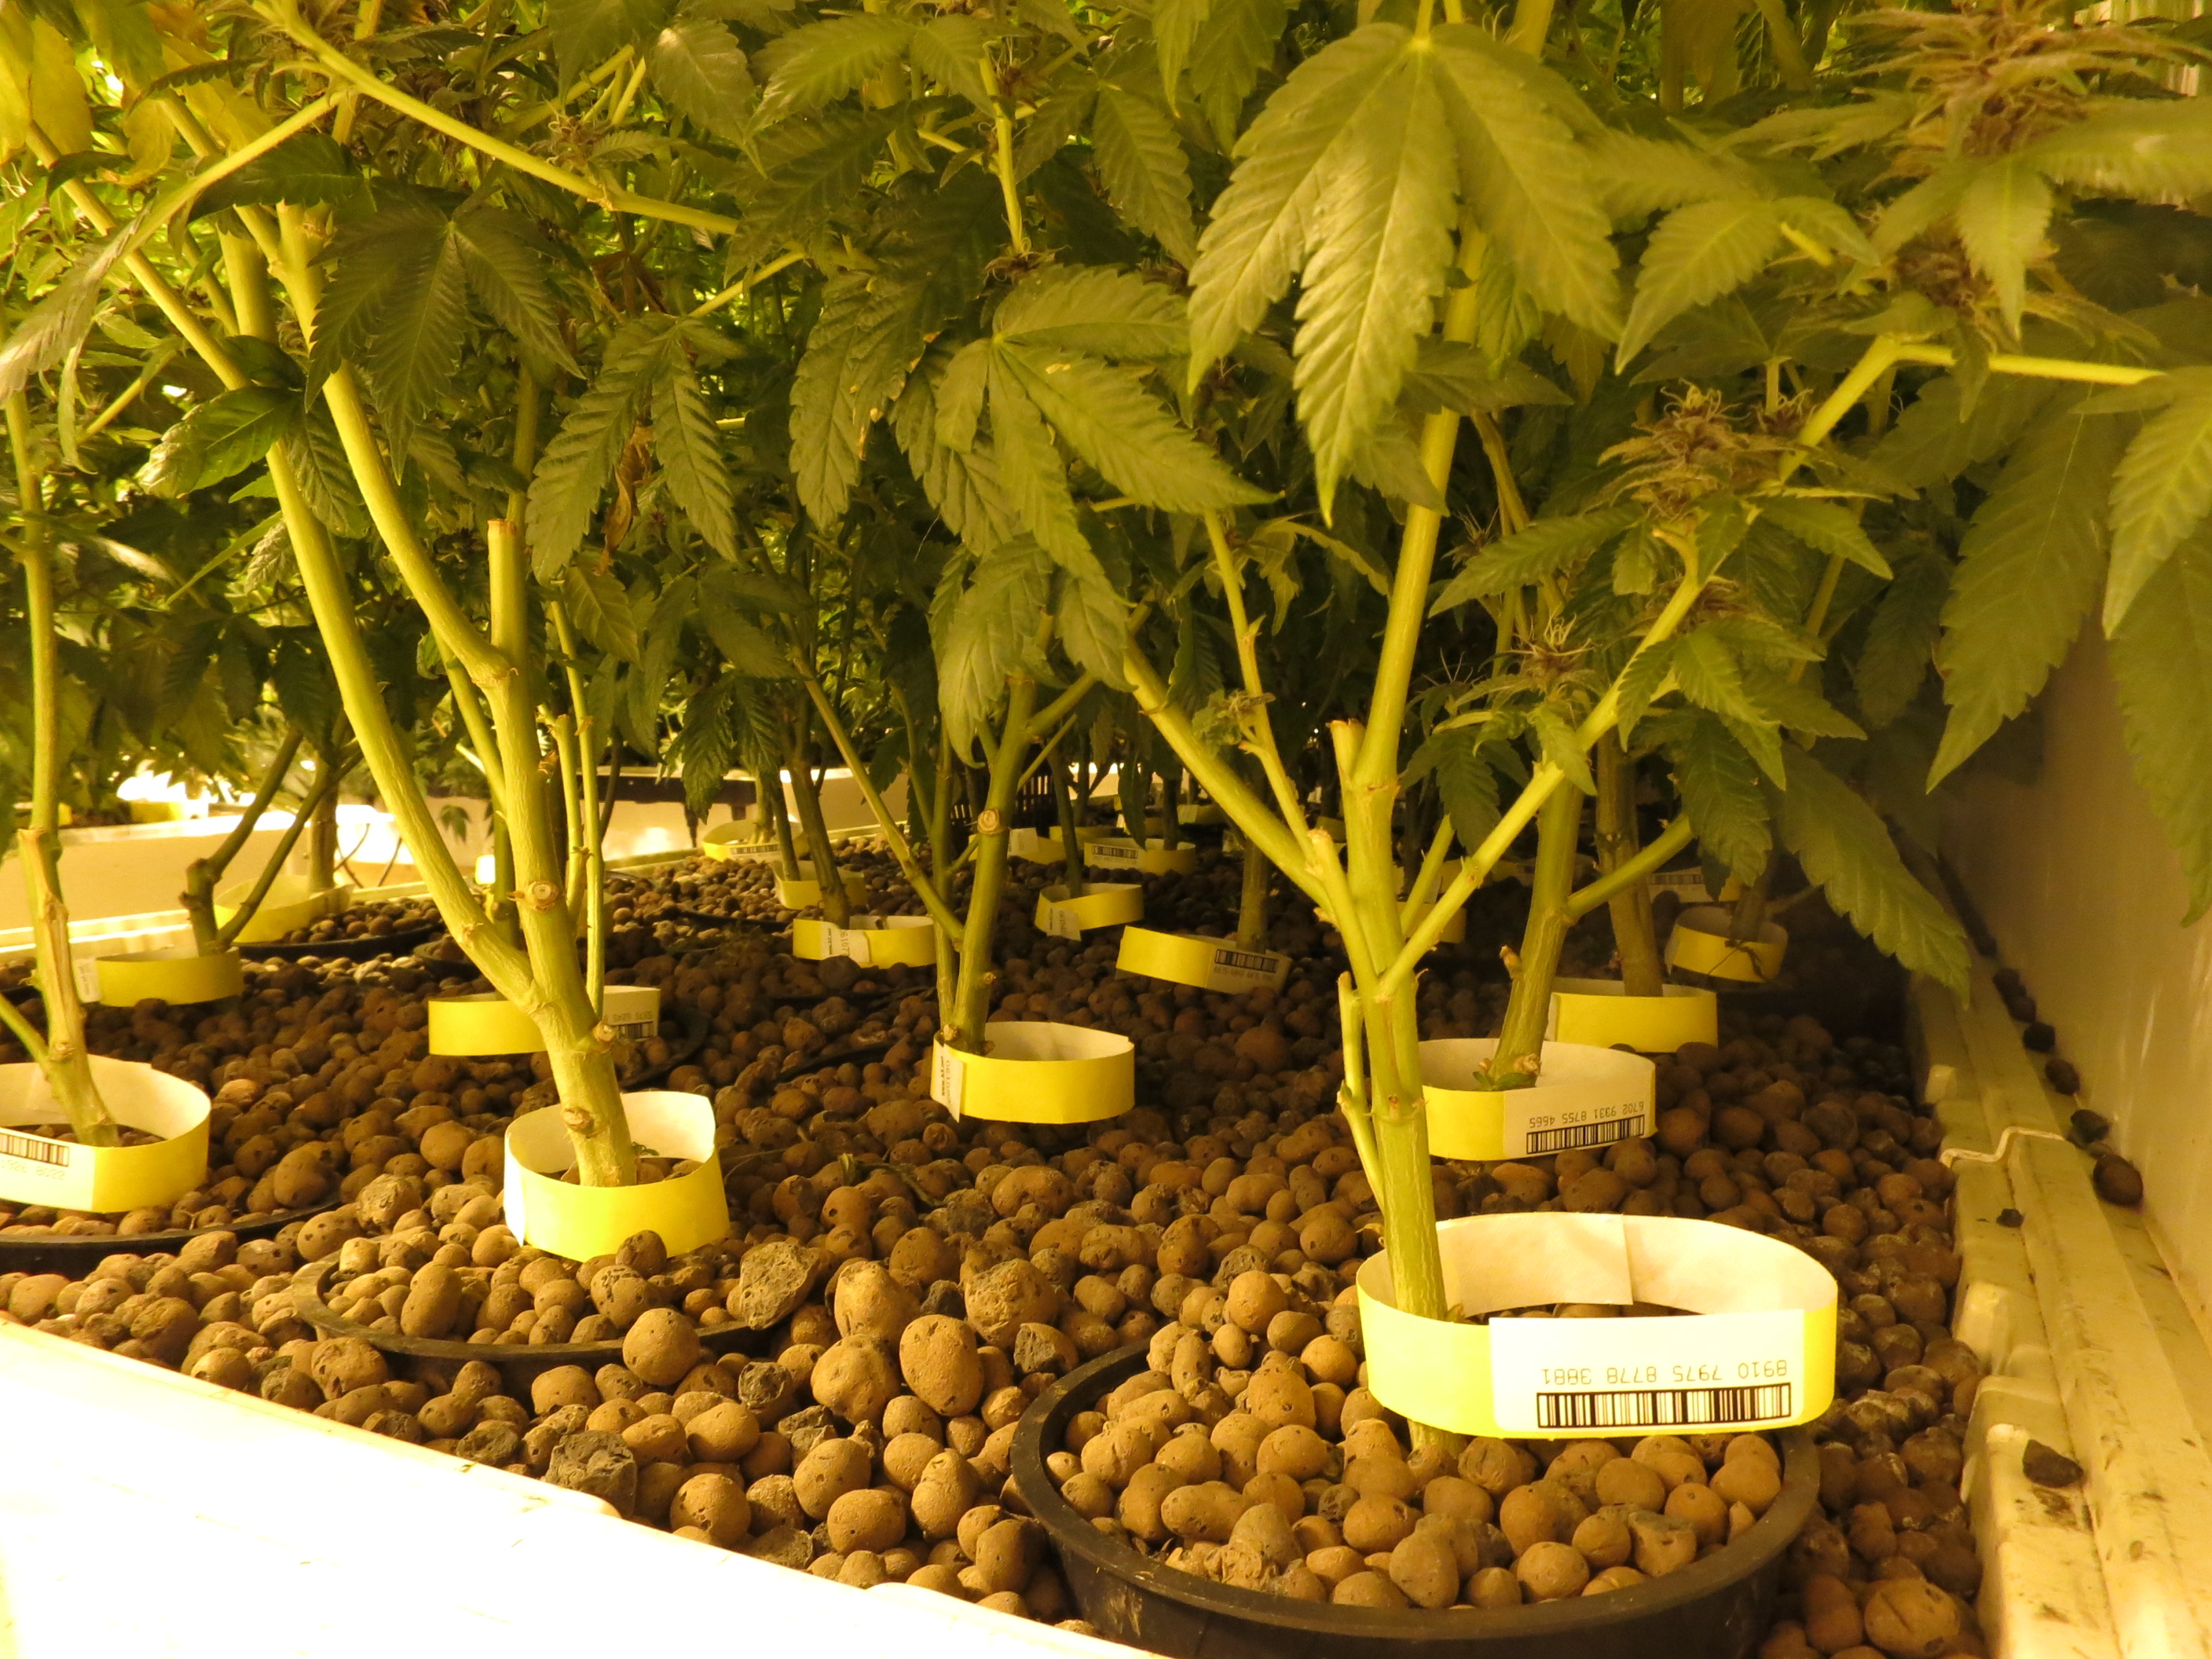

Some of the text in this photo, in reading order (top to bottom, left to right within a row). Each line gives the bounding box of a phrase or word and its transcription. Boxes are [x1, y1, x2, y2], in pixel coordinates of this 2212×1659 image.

[1529, 1101, 1645, 1129] 6702 9331 8755 4665
[1540, 1359, 1788, 1386] 8910 7975 8778 3881
